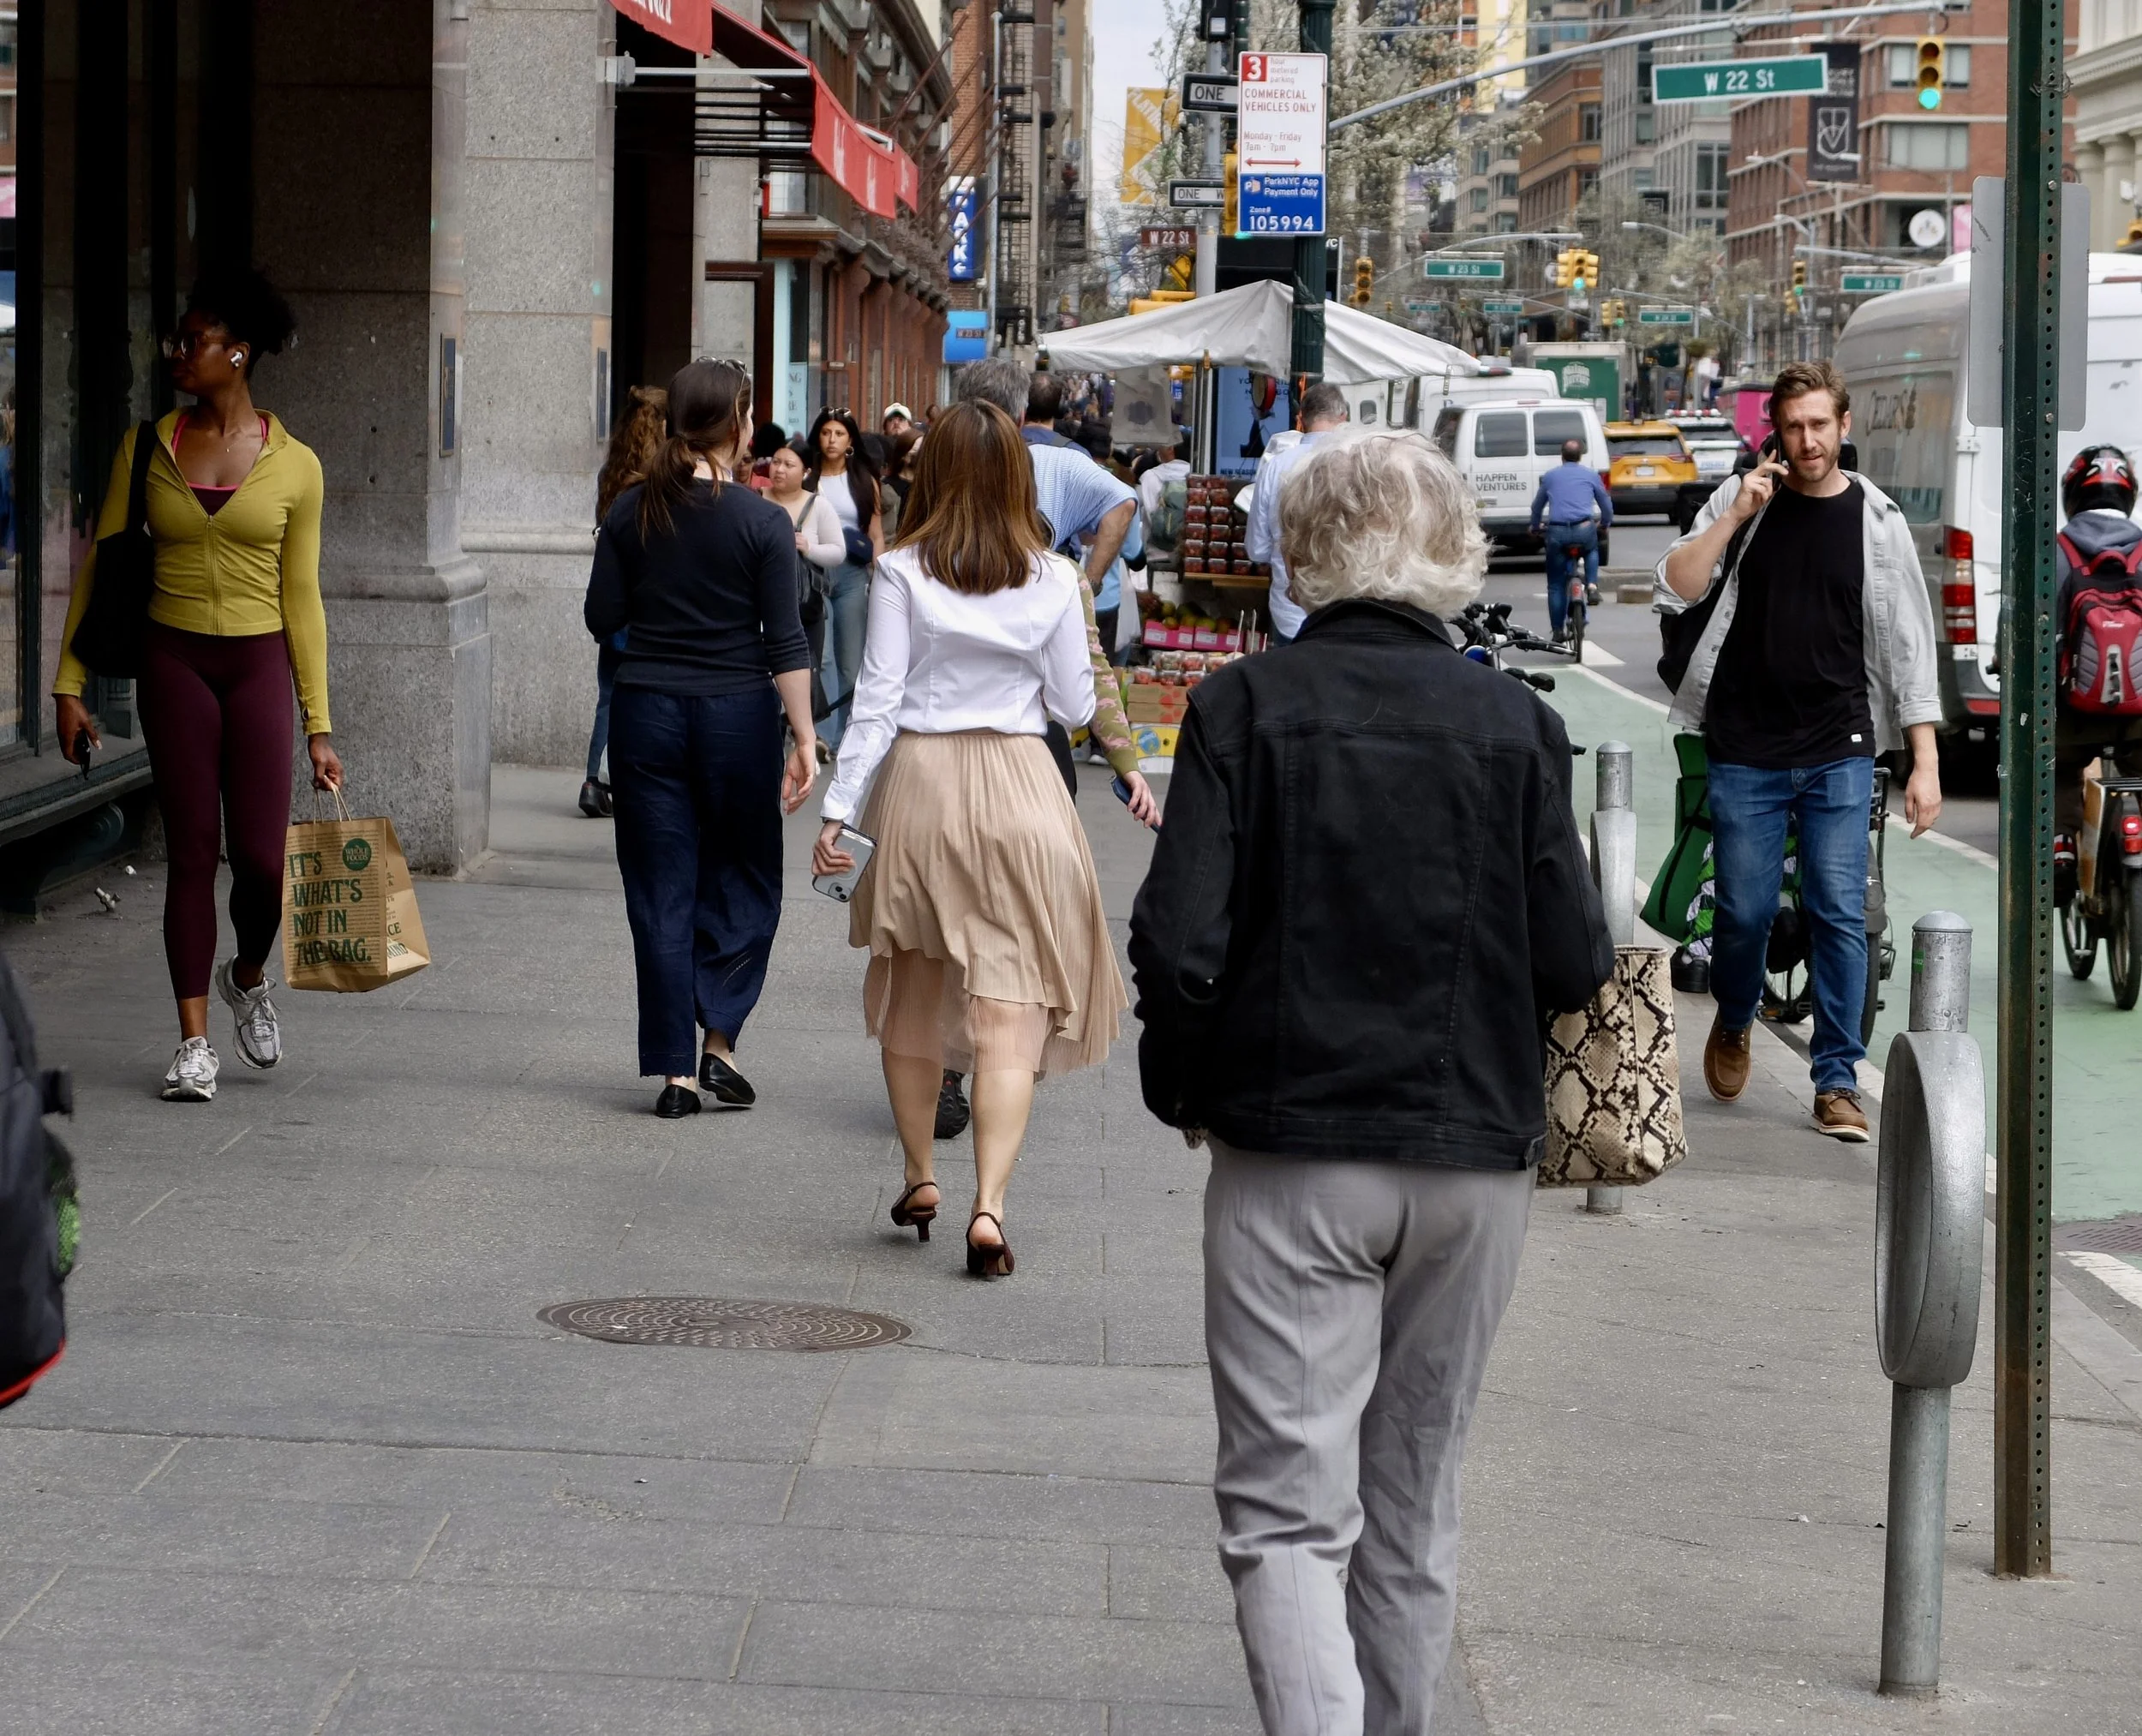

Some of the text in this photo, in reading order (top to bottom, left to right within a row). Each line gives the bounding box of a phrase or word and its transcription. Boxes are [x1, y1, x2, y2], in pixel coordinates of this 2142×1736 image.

[1248, 56, 1262, 81] 3
[1703, 68, 1775, 93] W 22 St
[1194, 86, 1225, 101] ONE
[1244, 88, 1307, 99] COMMERCIAL
[1244, 101, 1317, 113] VEHICLES ONLY
[1243, 131, 1272, 141] Monday
[1279, 131, 1302, 142] Friday
[1246, 142, 1261, 151] 7am
[1270, 142, 1287, 153] 7pm
[1265, 177, 1319, 187] ParkNYC App
[1178, 189, 1200, 200] ONE
[1265, 188, 1319, 198] Payment Only
[1249, 215, 1314, 230] 105994
[1149, 230, 1189, 244] W 22 St
[1448, 265, 1481, 274] W 23 St
[1475, 473, 1517, 482] HAPPEN
[1476, 482, 1527, 492] VENTURES
[288, 851, 322, 878] IT'S
[292, 878, 362, 907] WHAT'S
[293, 909, 347, 937] NOT IN
[294, 938, 372, 967] THE BAG.
